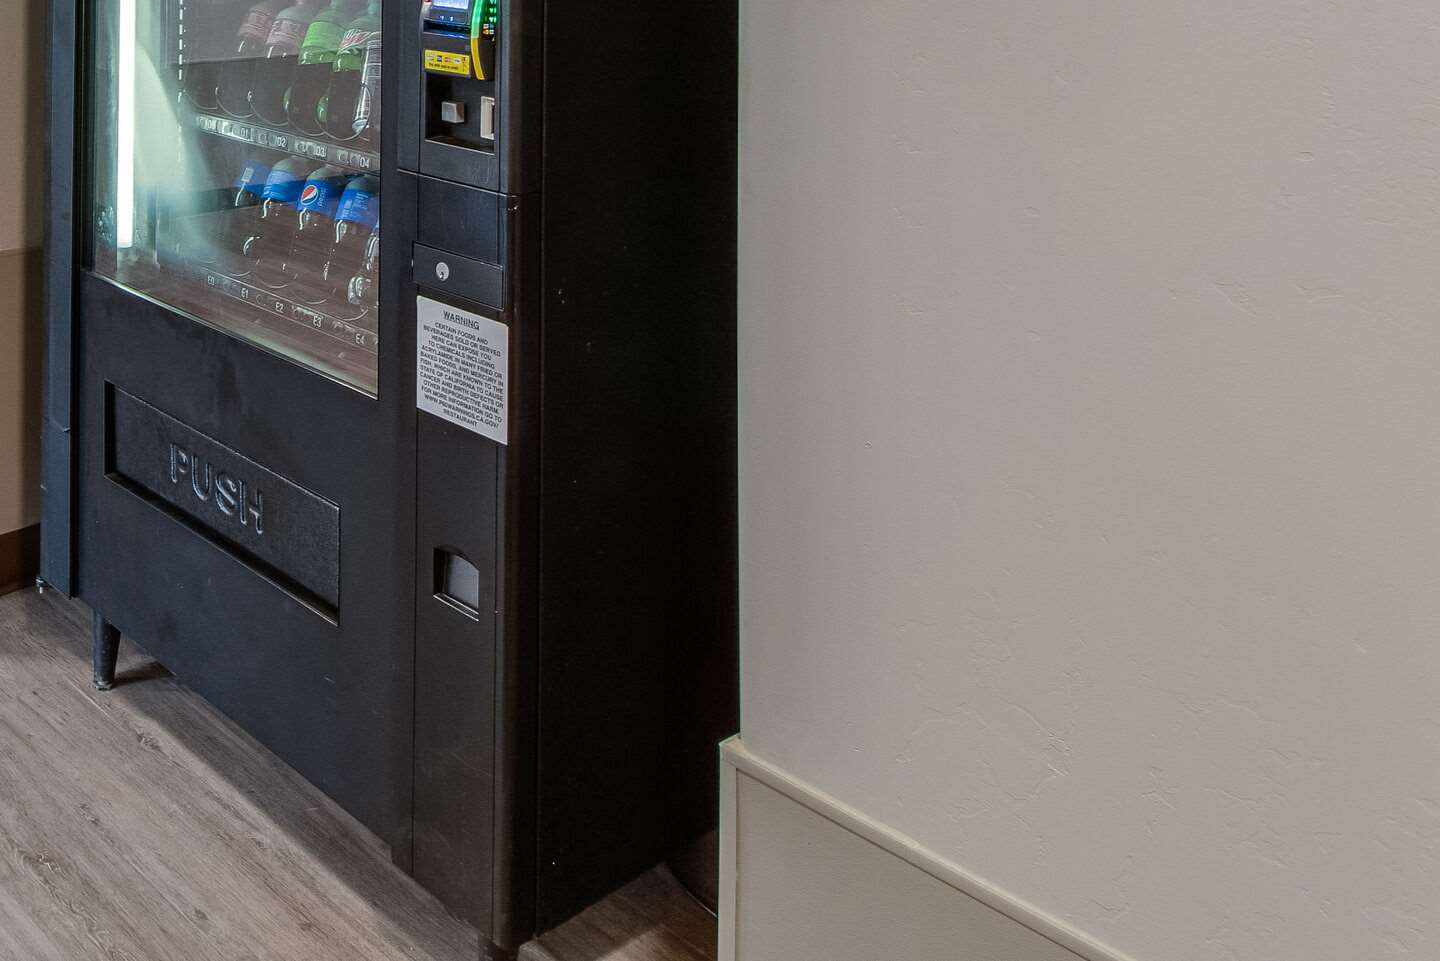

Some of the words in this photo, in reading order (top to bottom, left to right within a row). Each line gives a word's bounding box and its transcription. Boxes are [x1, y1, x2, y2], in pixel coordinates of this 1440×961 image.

[241, 287, 249, 299] E1
[275, 302, 284, 314] E2
[312, 315, 322, 328] E3
[355, 332, 365, 345] E4
[443, 311, 479, 330] WARNING
[423, 324, 453, 339] BEVERAGES
[454, 335, 469, 345] SOLD
[479, 344, 500, 356] SERVED
[431, 334, 444, 343] HERE
[446, 339, 456, 348] CAN
[458, 344, 478, 356] EXPOSE
[480, 352, 491, 360] YOU
[435, 322, 456, 333] CERTAIN
[458, 330, 475, 340] FOODS
[477, 336, 487, 345] AND
[421, 344, 453, 360] ACRYLAMIDE
[461, 359, 475, 369] MANY
[477, 365, 492, 375] FRIED
[436, 343, 465, 358] CHEMICALS
[420, 351, 437, 361] BAKED
[459, 365, 469, 374] AND
[470, 370, 496, 384] MERCURY
[420, 364, 434, 374] STATE
[444, 374, 475, 390] CALIFORNIA
[484, 389, 502, 400] CAUSE
[434, 363, 450, 373] WHICH
[451, 369, 461, 378] ARE
[463, 374, 482, 385] KNOWN
[493, 385, 502, 393] THE
[420, 371, 440, 383] CANCER
[441, 379, 452, 388] AND
[453, 384, 468, 394] BIRTH
[470, 390, 493, 404] DEFECTS
[495, 400, 503, 408] OR
[421, 385, 431, 393] FOR
[432, 390, 446, 400] MORE
[448, 396, 482, 414] INFORMATION
[494, 414, 501, 422] TO
[423, 379, 440, 390] OTHER
[441, 386, 481, 406] REPRODUCTIVE
[443, 408, 477, 427] RESTAURANT
[169, 443, 263, 534] PUSH
